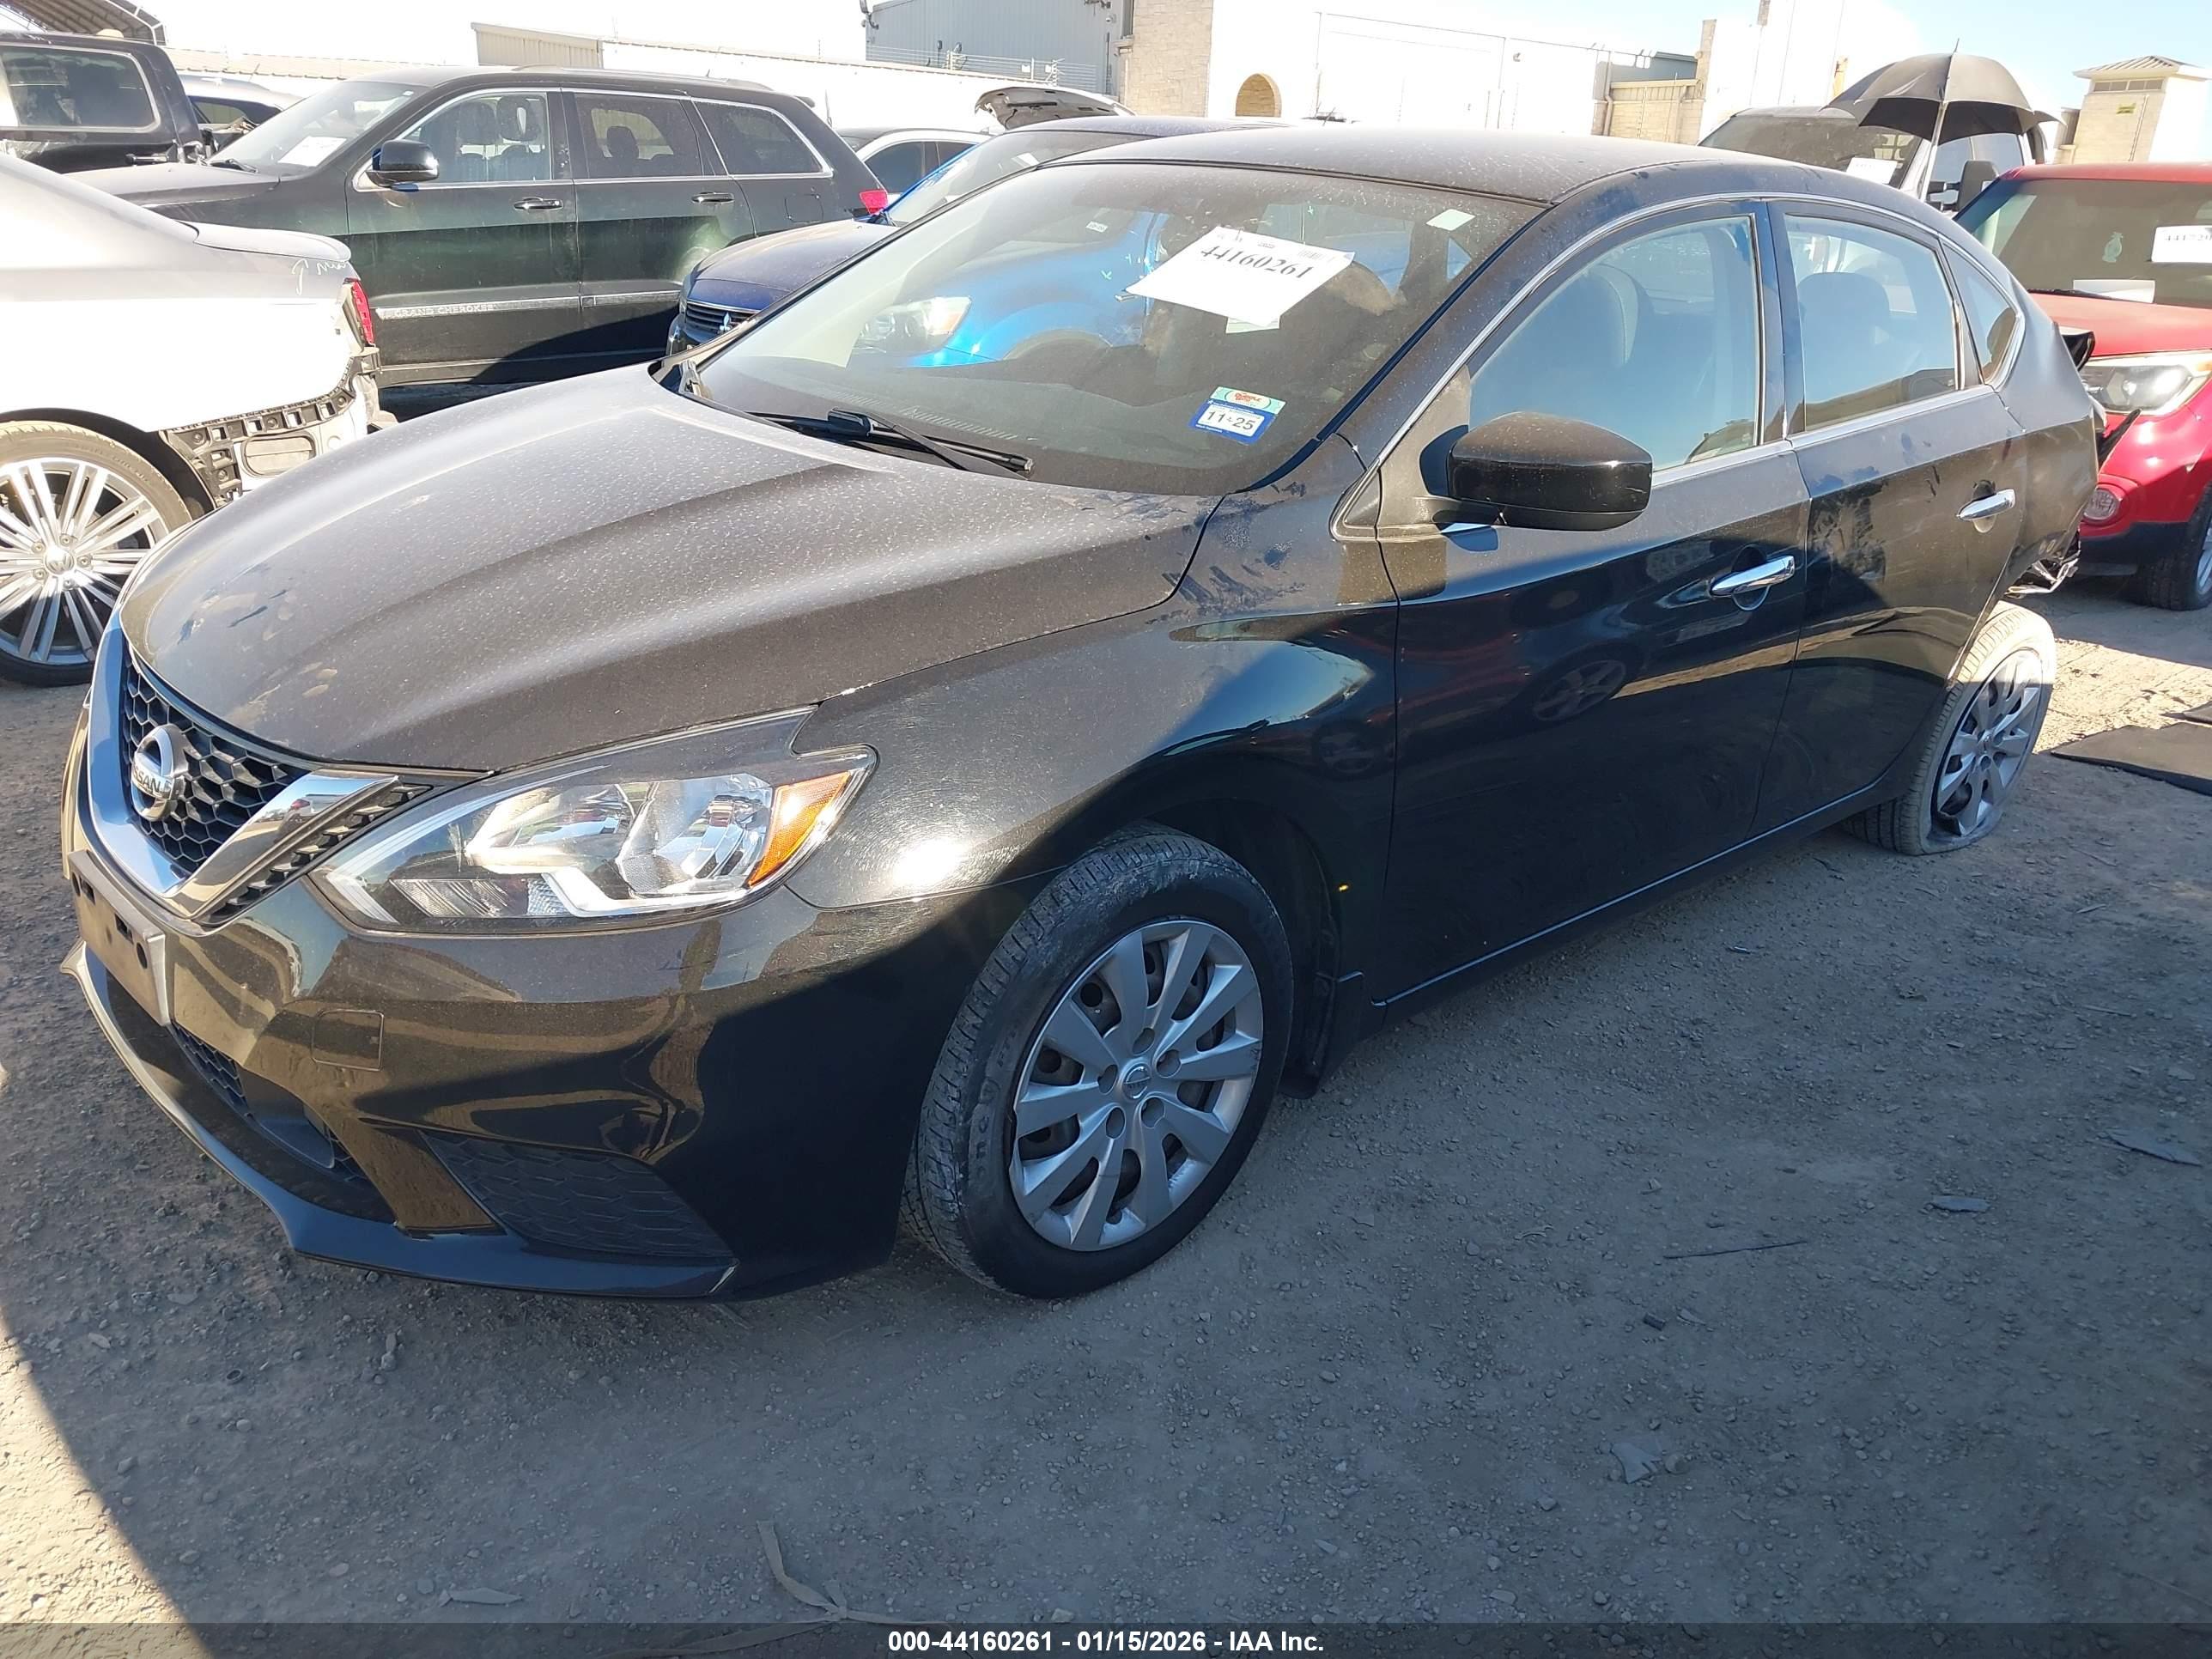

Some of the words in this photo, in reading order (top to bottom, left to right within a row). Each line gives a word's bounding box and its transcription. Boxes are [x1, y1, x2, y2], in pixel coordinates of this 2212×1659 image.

[1200, 245, 1314, 279] 44160261
[393, 307, 434, 319] GRAND
[437, 303, 495, 315] CHEROKEE
